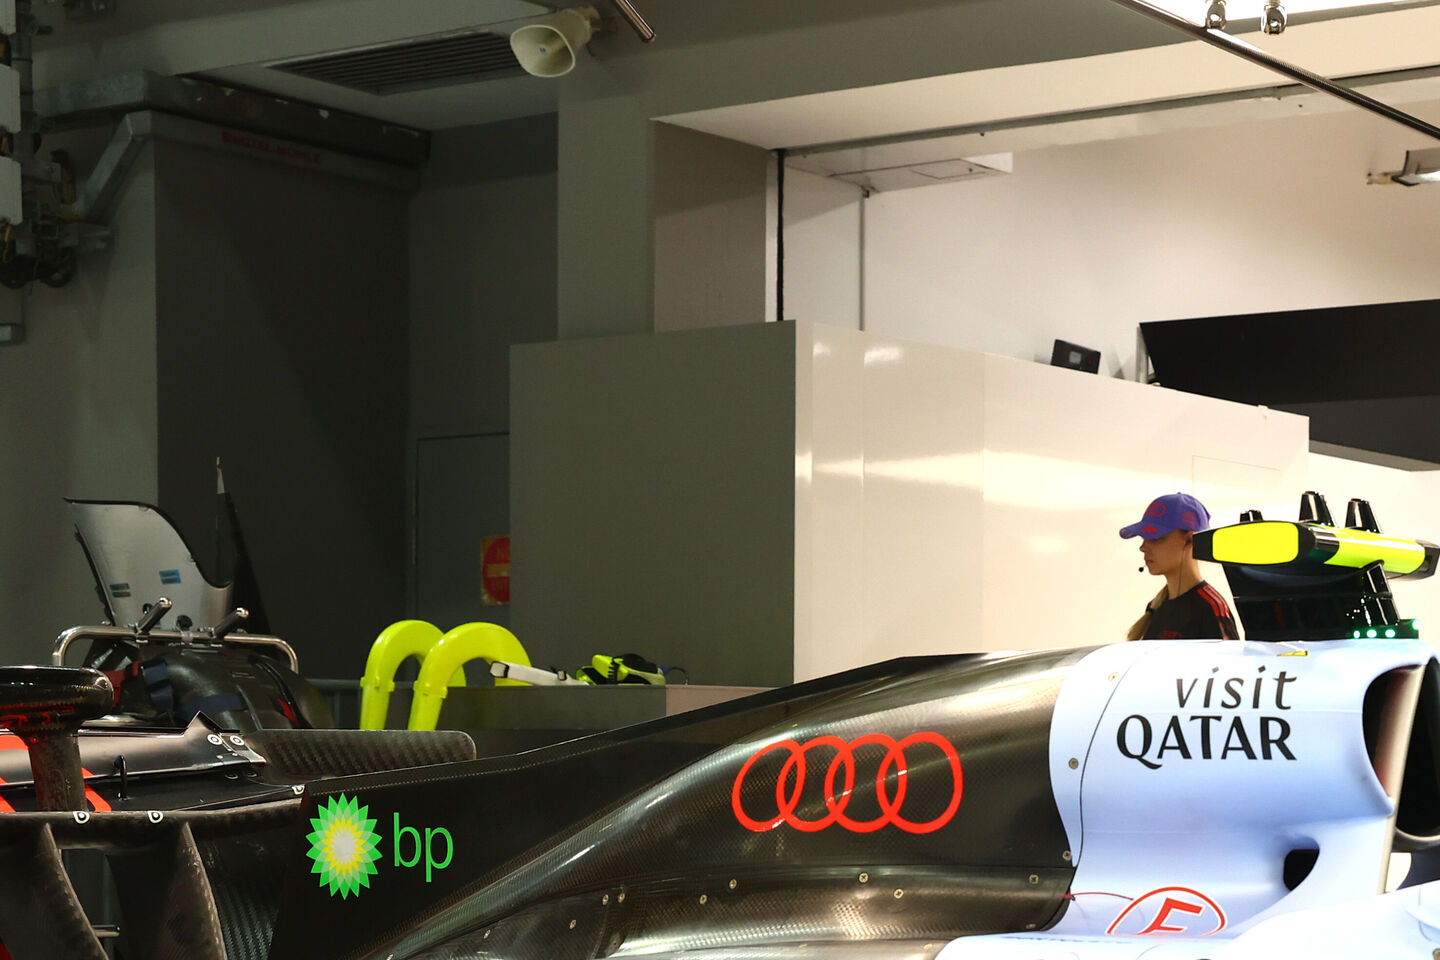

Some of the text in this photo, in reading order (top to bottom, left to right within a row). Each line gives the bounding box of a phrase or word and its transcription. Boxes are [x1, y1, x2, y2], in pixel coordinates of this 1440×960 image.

[1175, 665, 1298, 710] visit
[1116, 715, 1298, 769] QATAR
[393, 812, 454, 882] bp
